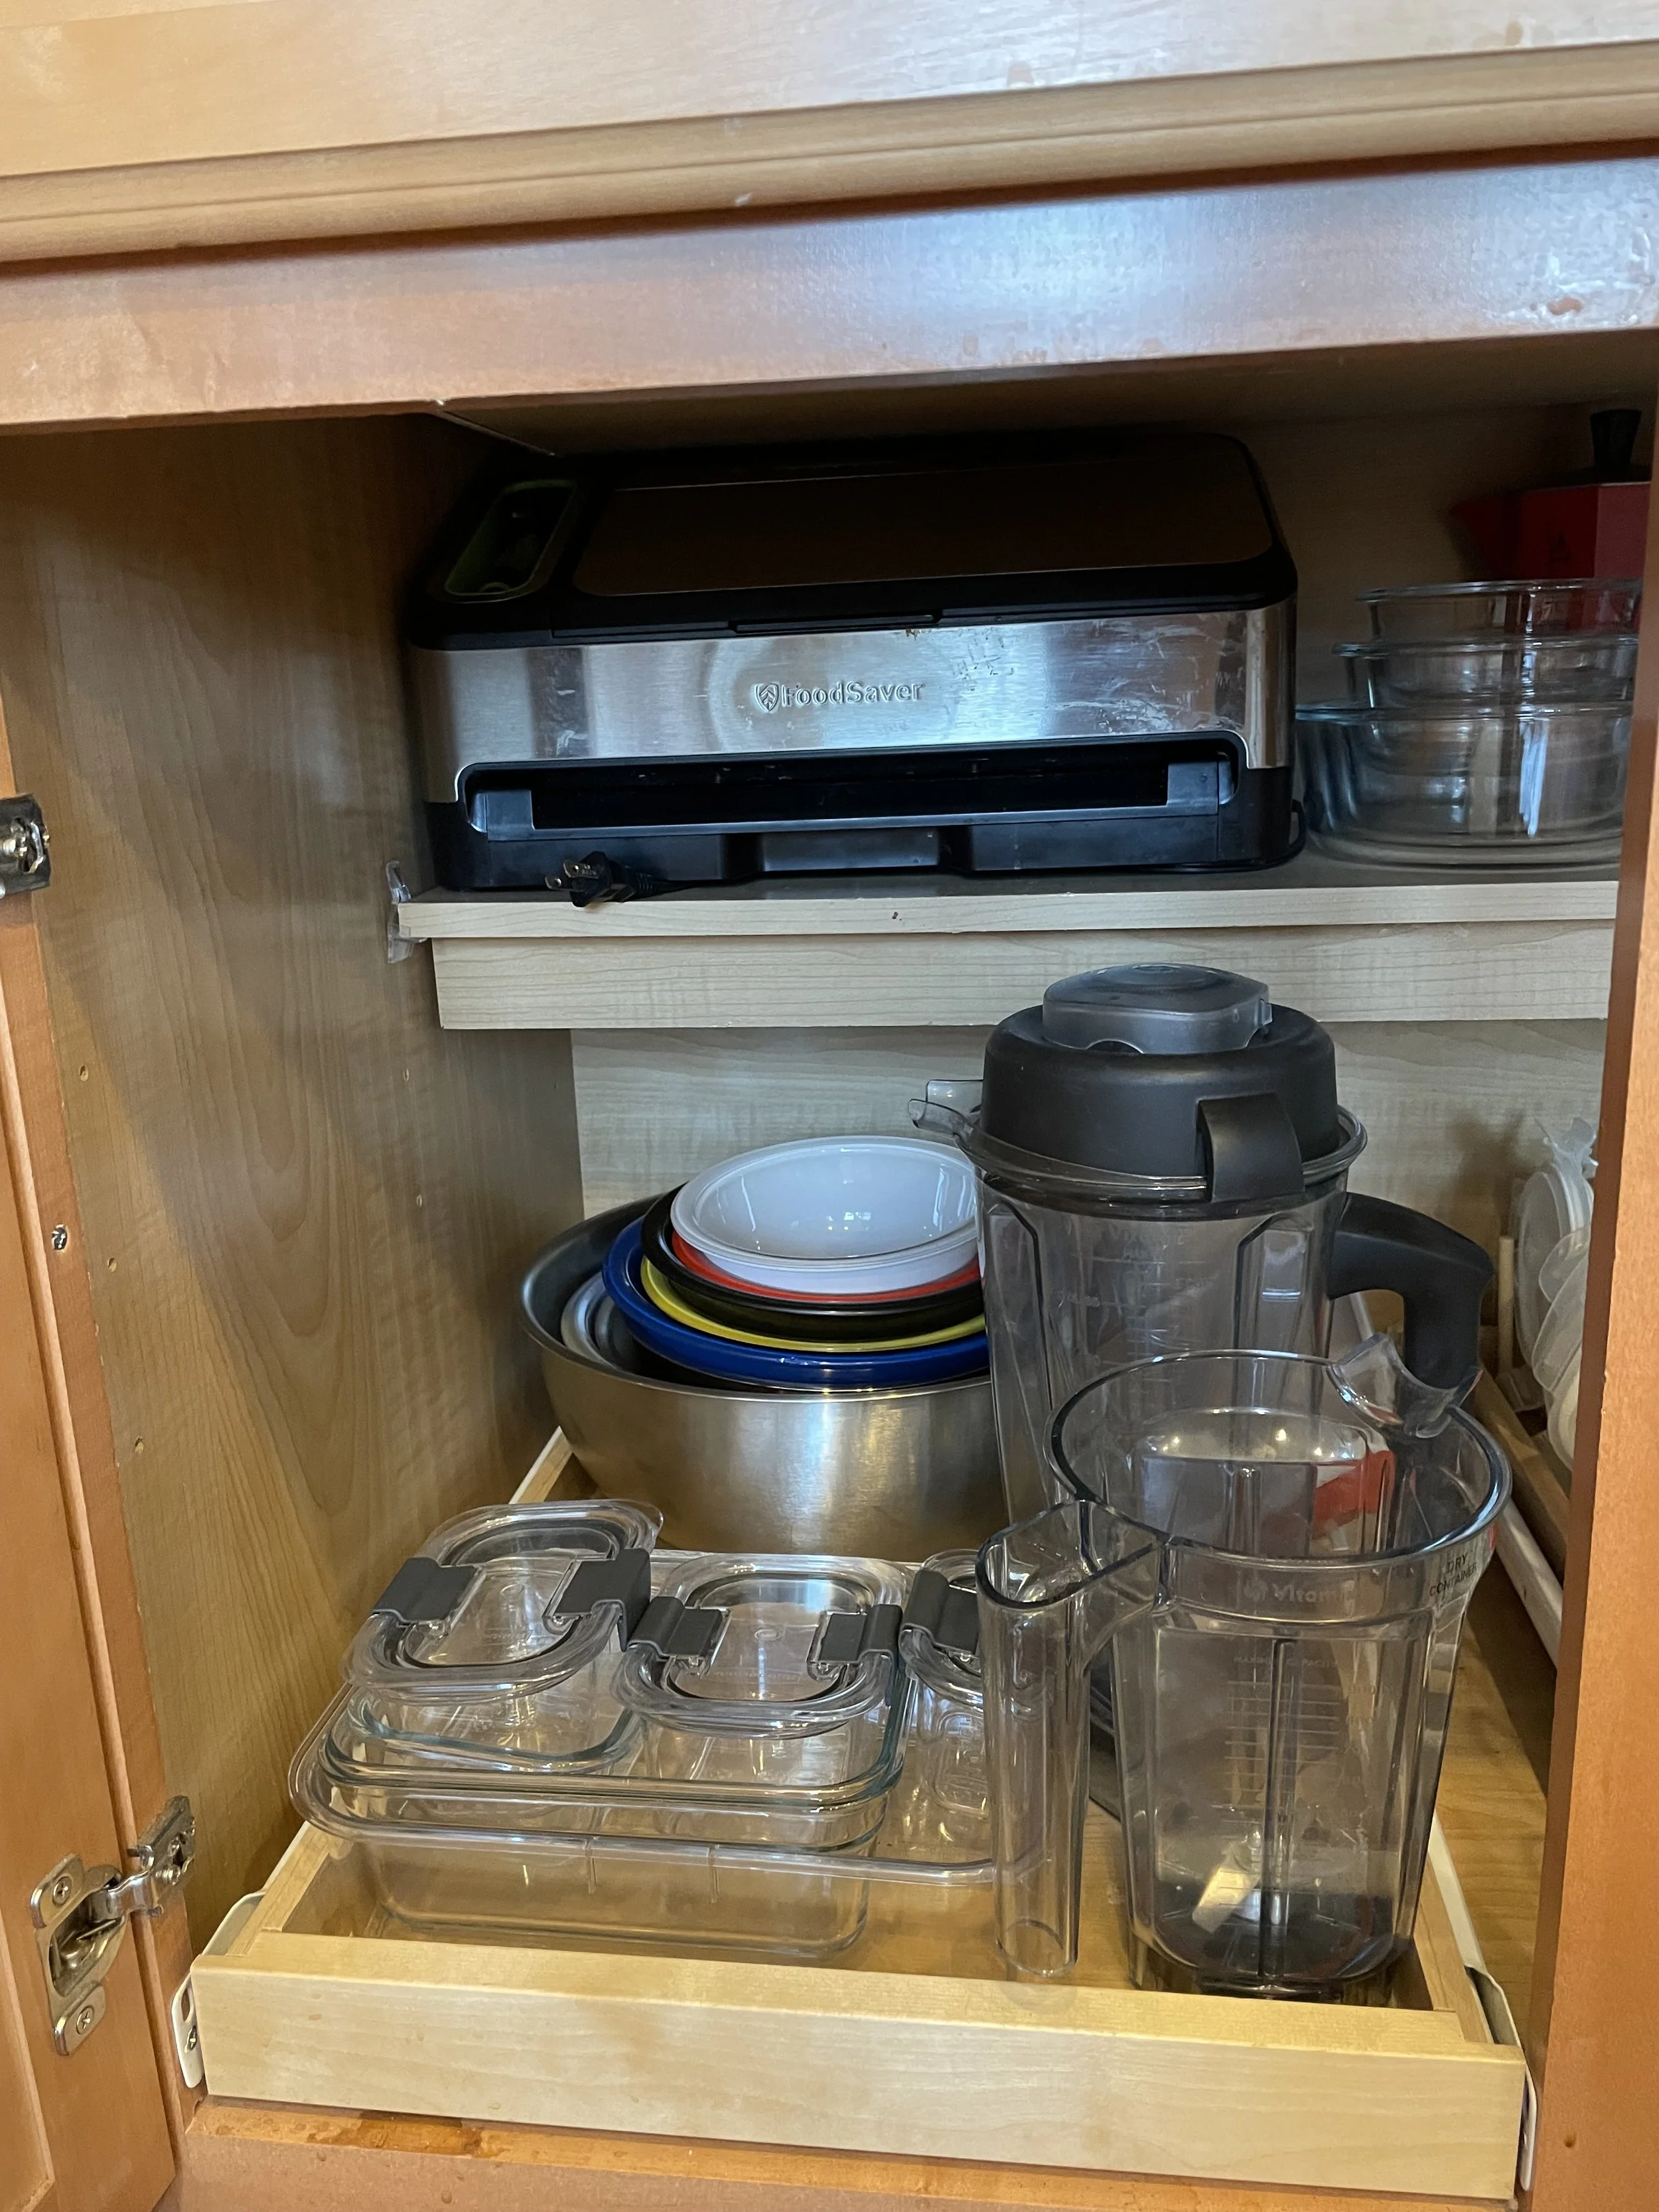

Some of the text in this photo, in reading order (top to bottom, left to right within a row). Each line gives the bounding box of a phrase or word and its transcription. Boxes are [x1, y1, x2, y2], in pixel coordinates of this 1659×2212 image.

[782, 680, 926, 707] FoodSaver
[1447, 1552, 1469, 1574] DRY
[1429, 1562, 1477, 1597] CONTAINER
[1271, 1582, 1351, 1603] Vitam
